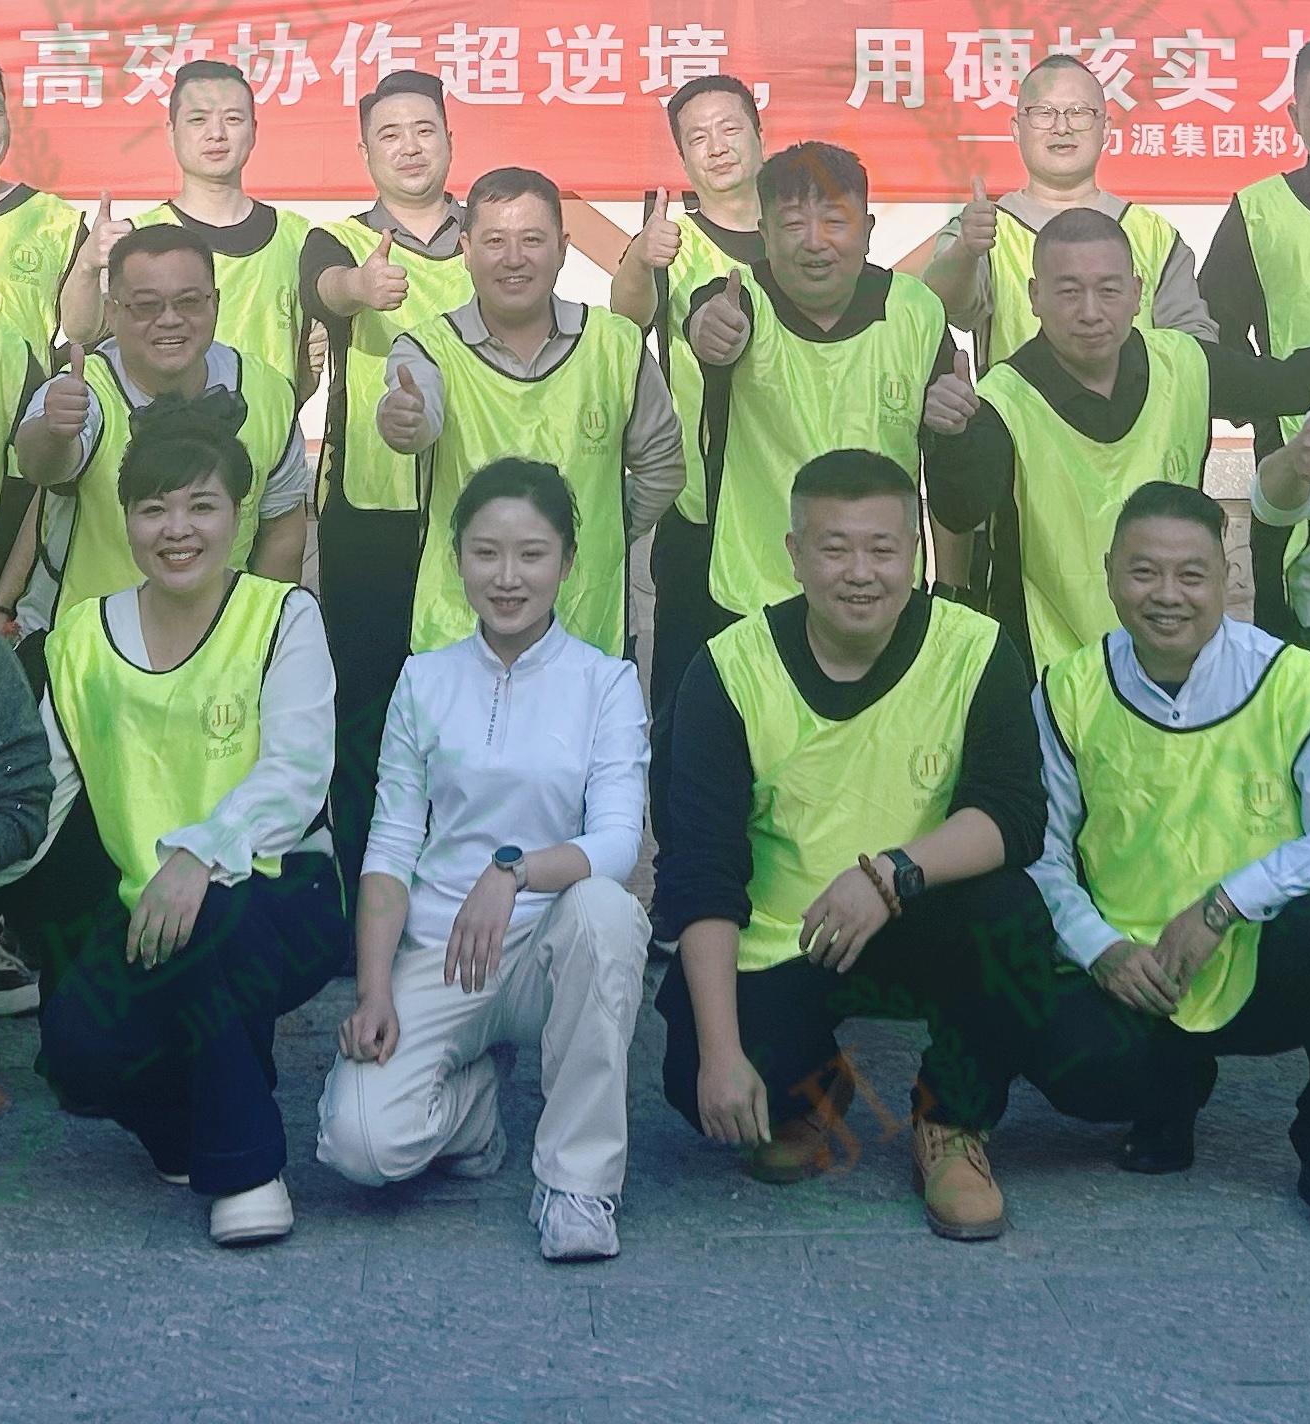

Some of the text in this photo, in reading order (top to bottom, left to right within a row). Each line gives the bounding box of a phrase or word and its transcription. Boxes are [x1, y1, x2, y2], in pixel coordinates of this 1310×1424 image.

[17, 250, 37, 264] JL
[885, 380, 906, 401] JL
[584, 410, 604, 431] JL
[211, 704, 237, 727] JL
[205, 742, 243, 761] 健力源
